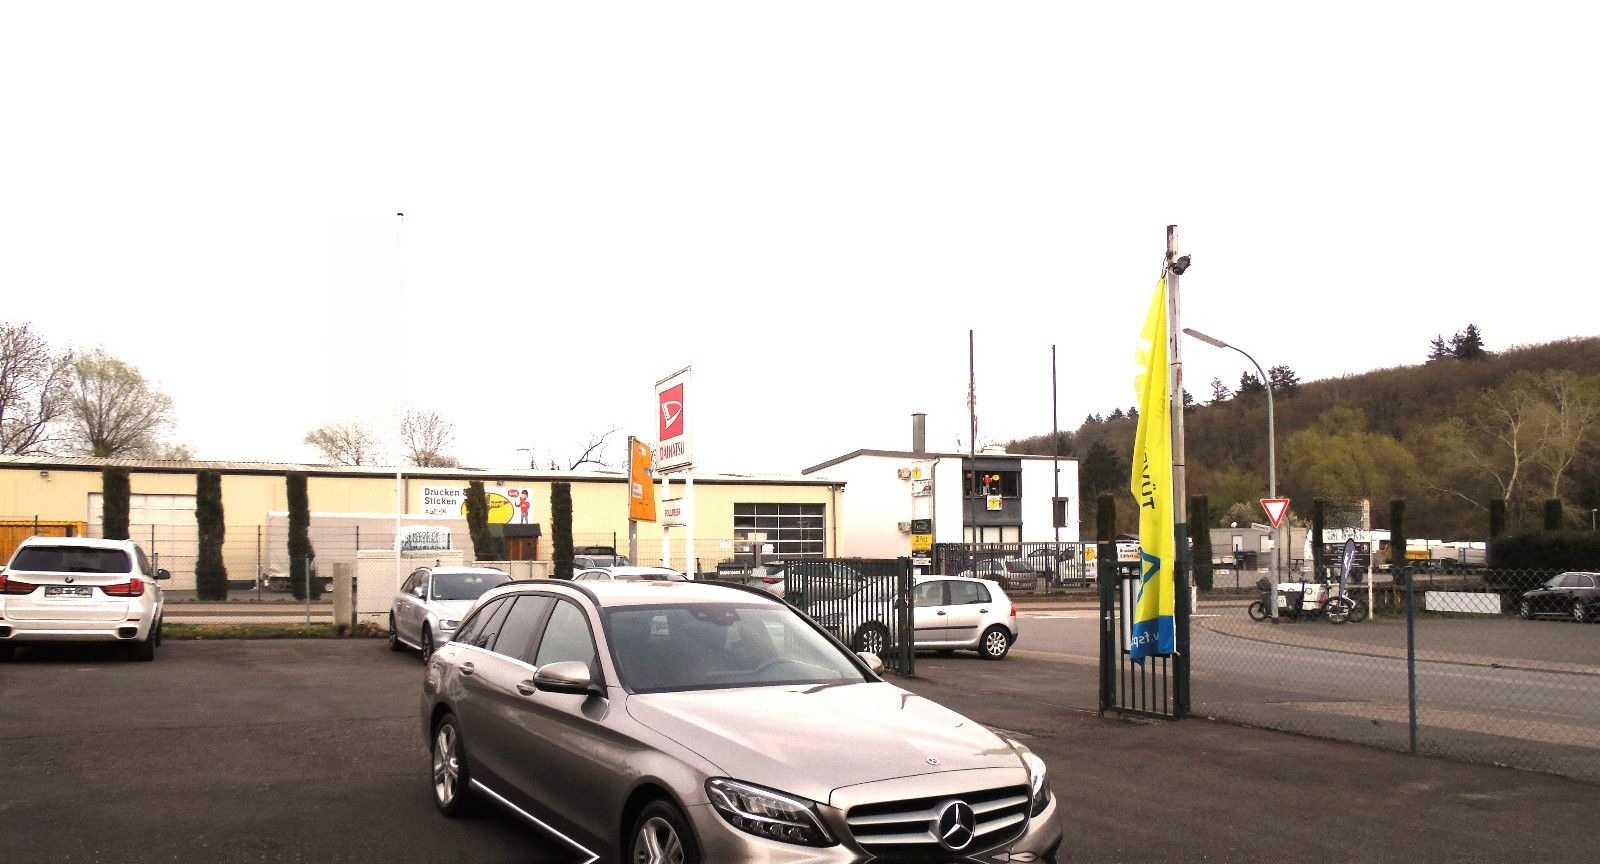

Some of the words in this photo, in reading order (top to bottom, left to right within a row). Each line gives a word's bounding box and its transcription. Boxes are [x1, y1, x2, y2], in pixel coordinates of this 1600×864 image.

[659, 441, 684, 461] DAIHATSU
[424, 488, 460, 497] Drucken
[424, 496, 457, 505] Sticken
